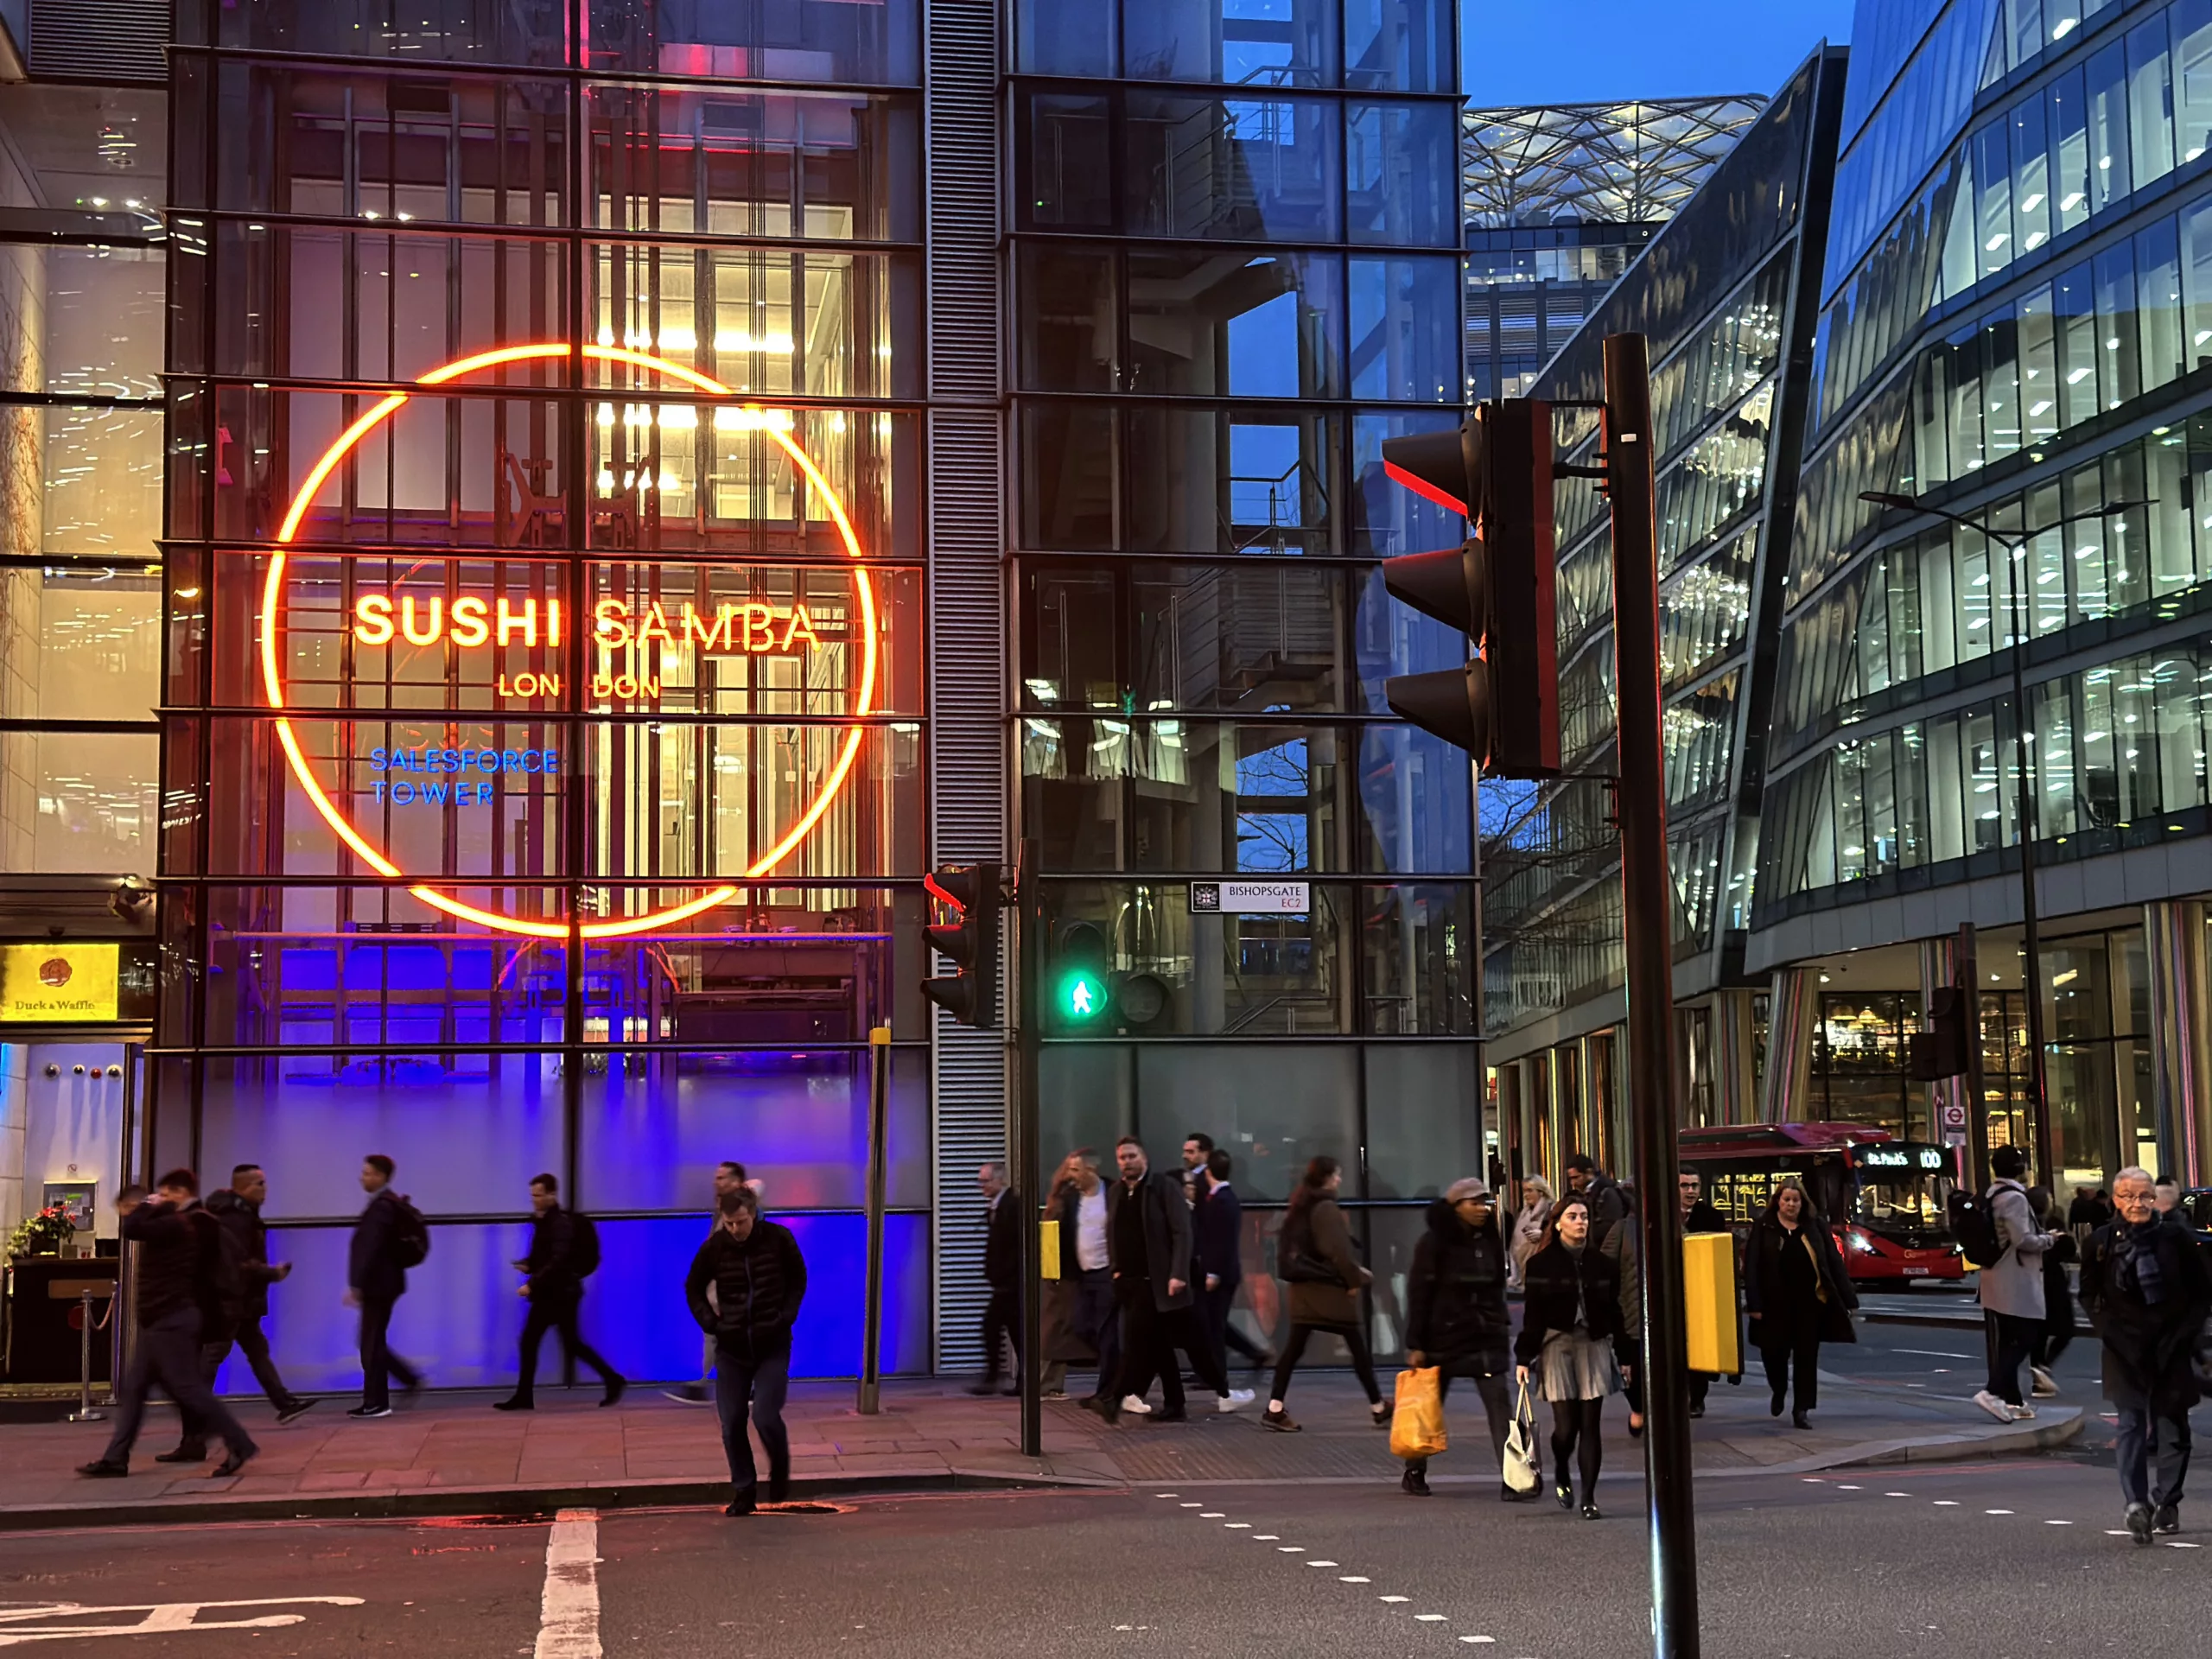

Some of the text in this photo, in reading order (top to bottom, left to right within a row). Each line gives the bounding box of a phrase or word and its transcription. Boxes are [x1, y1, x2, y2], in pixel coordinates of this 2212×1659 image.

[354, 594, 821, 652] SUSHI SAMBA
[499, 672, 658, 699] LON DON
[370, 747, 558, 773] SALESFORCE
[370, 781, 493, 806] TOWER
[1229, 886, 1302, 896] BISHOPSGATE
[1281, 898, 1301, 908] EC2
[15, 1000, 48, 1010] Duck
[56, 1000, 95, 1010] Waffle
[1919, 1150, 1942, 1168] 100
